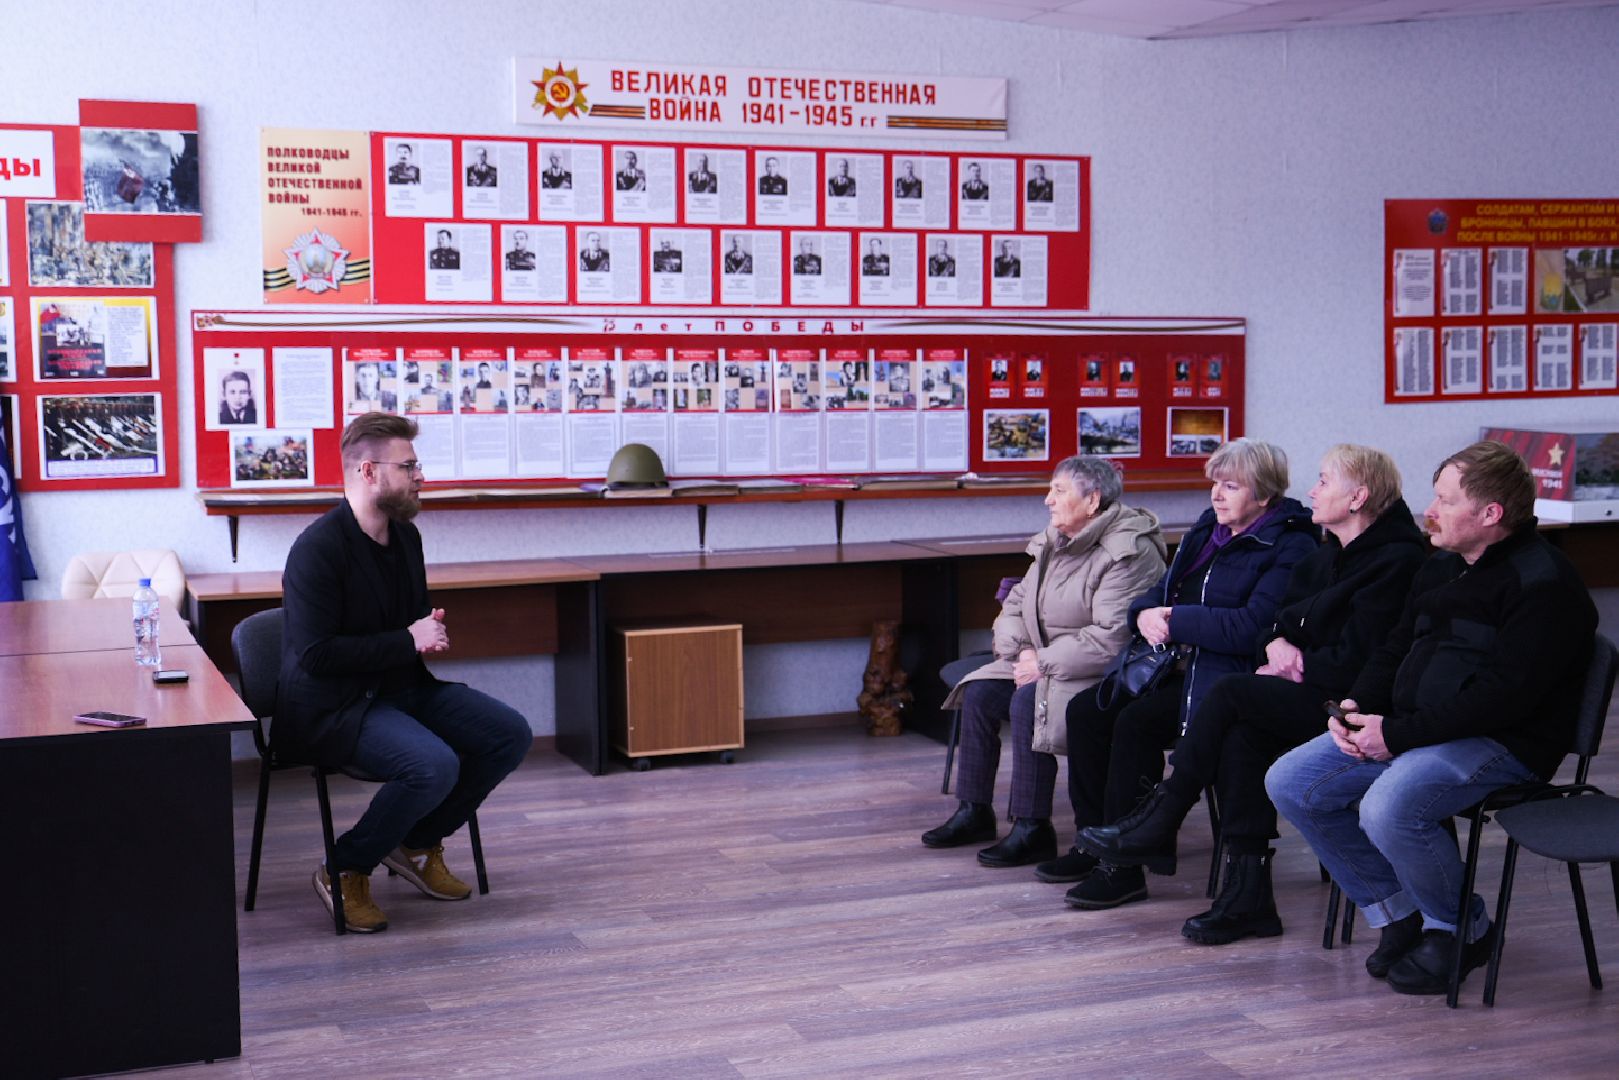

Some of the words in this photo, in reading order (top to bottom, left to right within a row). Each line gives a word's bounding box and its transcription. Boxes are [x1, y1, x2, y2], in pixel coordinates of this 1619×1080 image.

[611, 70, 727, 98] ВЕЛИКАЯ
[747, 76, 936, 106] ОТЕЧЕСТВЕННАЯ
[649, 97, 722, 123] ВОЙНА
[742, 103, 852, 127] 1941-1945
[267, 147, 350, 160] ПОЛКОВОДЦЫ
[267, 162, 321, 173] ВЕЛИКОЙ
[268, 178, 363, 190] ОТЕЧЕСТВЕННОЙ
[268, 192, 310, 204] ВОЙНЫ
